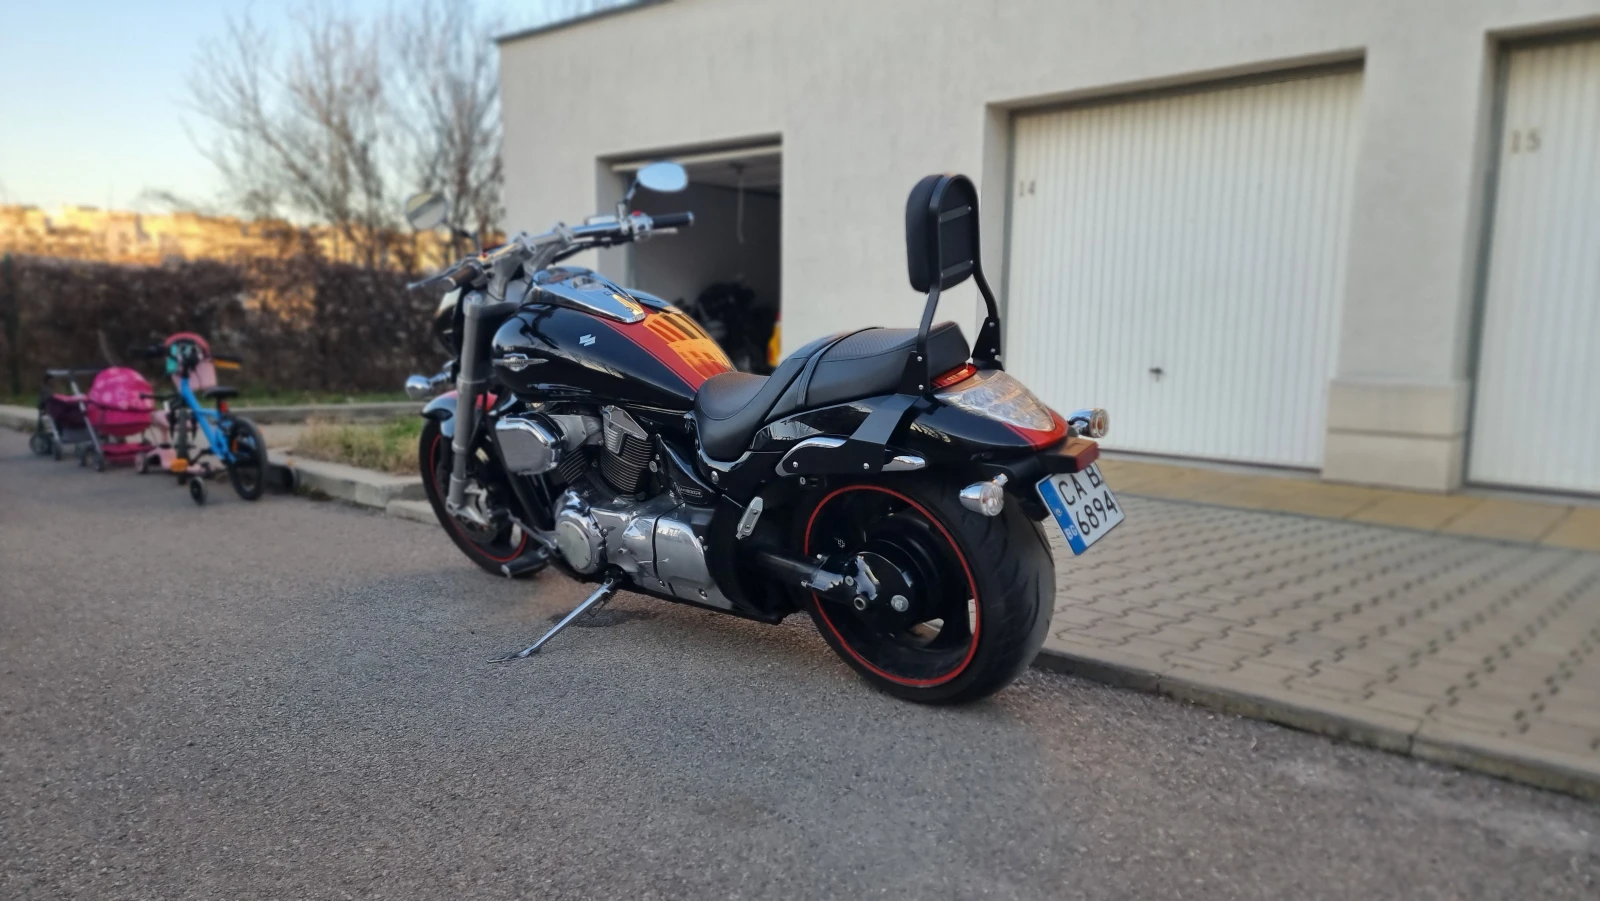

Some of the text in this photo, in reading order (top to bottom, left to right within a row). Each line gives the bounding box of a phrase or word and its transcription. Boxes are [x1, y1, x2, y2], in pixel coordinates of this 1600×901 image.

[1510, 128, 1541, 154] 15
[1018, 180, 1036, 198] 14
[1058, 474, 1088, 506] CA
[1076, 490, 1118, 536] 6894
[1064, 524, 1078, 540] BG
